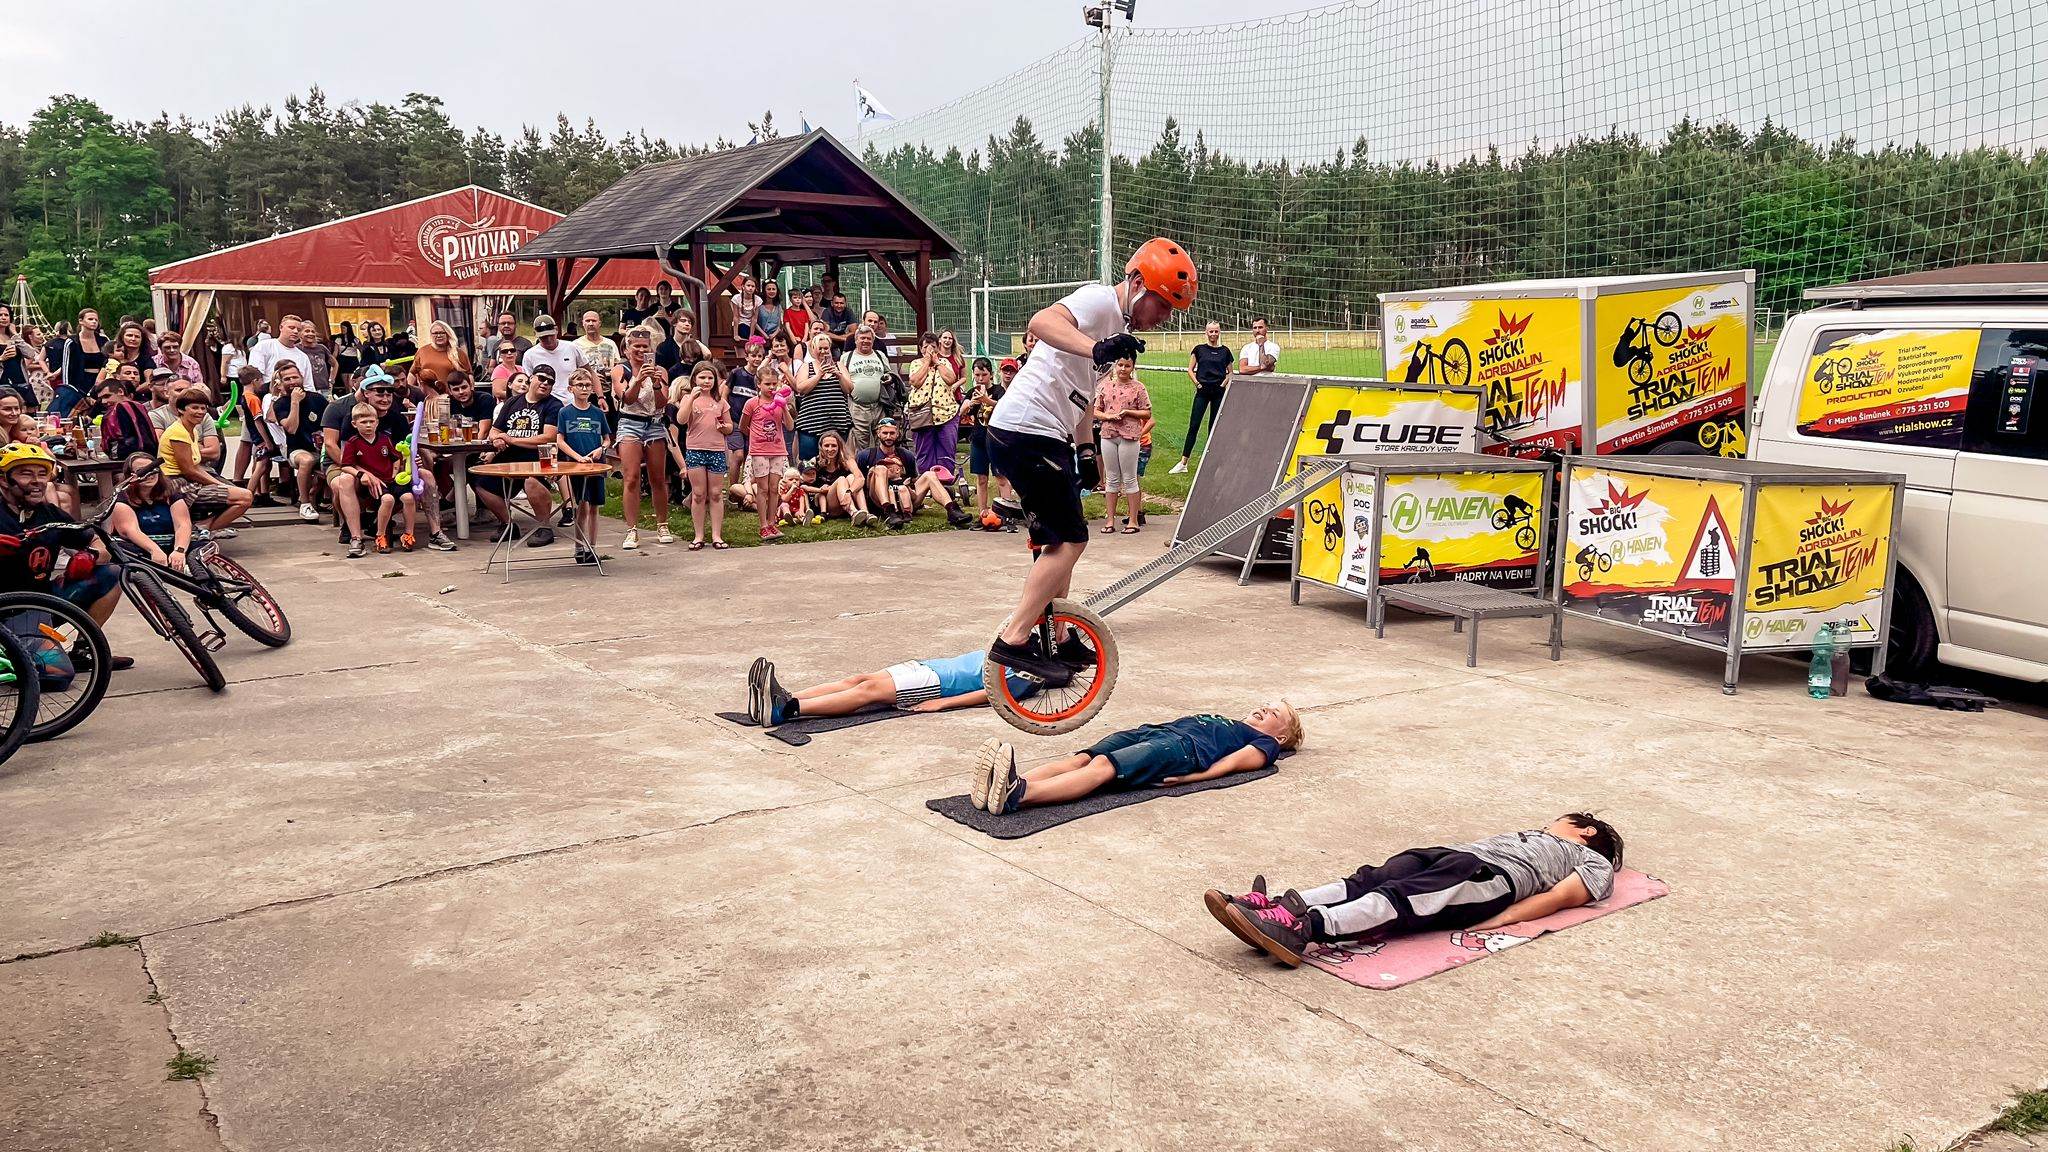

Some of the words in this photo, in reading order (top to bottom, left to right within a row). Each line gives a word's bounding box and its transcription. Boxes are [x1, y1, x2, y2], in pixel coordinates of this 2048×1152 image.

[442, 230, 520, 277] PIVOVAR
[453, 262, 480, 280] Velké
[481, 260, 516, 275] Březno
[1479, 337, 1525, 367] SHOCK!
[1669, 341, 1709, 364] SHOCK!
[1898, 353, 1921, 362] Biketrial
[1934, 354, 1963, 364] programy
[1477, 352, 1543, 382] ADRENALIN
[1656, 351, 1712, 378] ADRENALIN
[1923, 364, 1951, 374] programy
[1627, 369, 1696, 404] TRIAL
[1687, 357, 1731, 395] TEAM
[1836, 378, 1874, 391] SHOW
[1838, 371, 1874, 383] TRIAL
[1511, 367, 1567, 427] TEAM
[1627, 383, 1696, 421] SHOW
[1827, 388, 1892, 405] PRODUCTION
[1621, 432, 1646, 445] Martin
[1688, 409, 1703, 420] 775
[1704, 404, 1716, 416] 231
[1718, 397, 1733, 408] 509
[1834, 416, 1857, 424] Martin
[1902, 406, 1916, 414] 775
[1918, 403, 1931, 412] 231
[1934, 401, 1950, 409] 509
[1353, 424, 1464, 445] CUBE
[1879, 418, 1953, 435] www.trialshow.cz
[1374, 444, 1400, 452] STORE
[1426, 497, 1495, 521] HAVEN
[1610, 506, 1621, 514] BIG
[1579, 512, 1638, 536] SHOCK!
[1800, 518, 1844, 542] SHOCK!
[1627, 536, 1662, 554] HAVEN
[1796, 528, 1861, 555] ADRENALIN
[1758, 549, 1841, 585] TRIAL
[1832, 537, 1878, 582] TEAM
[1455, 571, 1488, 582] HADRY
[1489, 571, 1503, 580] NA
[1505, 570, 1523, 580] VEN
[1754, 566, 1841, 606] SHOW
[1643, 609, 1698, 625] SHOW
[1648, 595, 1698, 612] TRIAL
[1692, 598, 1727, 629] TEAM
[1765, 619, 1808, 632] HAVEN
